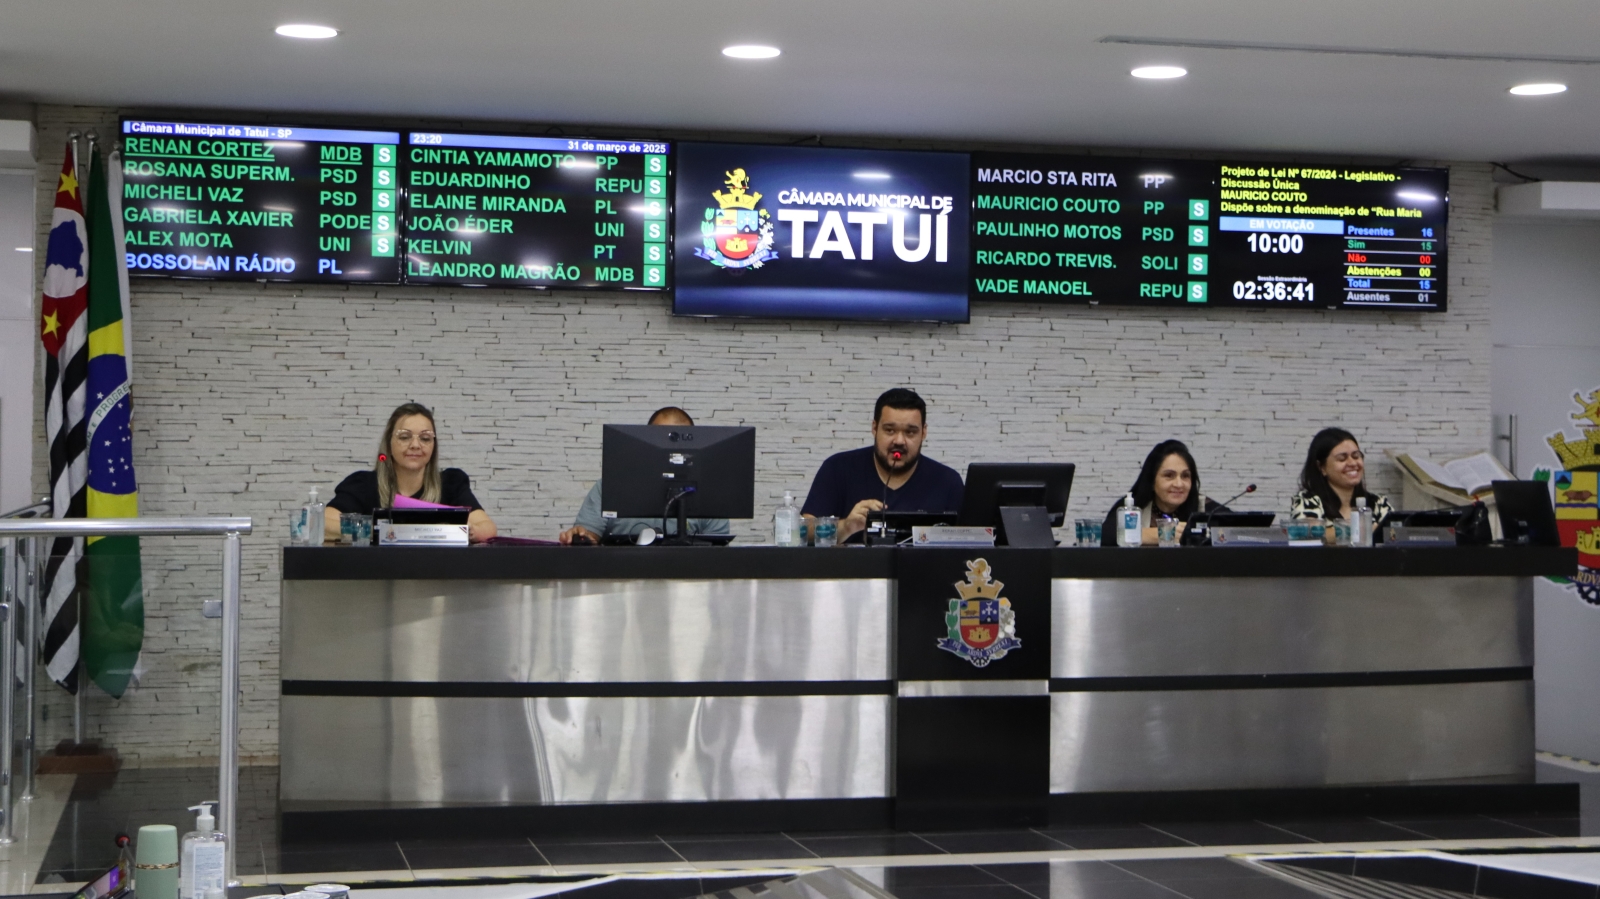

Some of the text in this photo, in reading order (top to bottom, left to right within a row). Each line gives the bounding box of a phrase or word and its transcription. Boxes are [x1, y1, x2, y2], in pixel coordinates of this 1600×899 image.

[131, 122, 172, 135] Câmara
[175, 124, 227, 137] Municipal
[229, 127, 242, 136] de
[277, 129, 292, 138] SP
[413, 134, 442, 144] 23:20
[125, 138, 391, 163] RENAN CORTEZ MDB S
[567, 141, 666, 153] 31 de março de 2025
[410, 149, 661, 172] CINTIA YAMAMOTO PP S
[124, 161, 390, 185] ROSANA SUPERM. PSD S
[410, 171, 661, 194] EDUARDINHO REPU S
[977, 168, 1165, 188] MARCIO STA RITA PP
[1221, 166, 1255, 178] Projeto
[1257, 167, 1270, 177] de
[1271, 168, 1286, 178] Lei
[1301, 169, 1337, 180] 67/2024
[1344, 170, 1395, 182] Legislativo
[1221, 178, 1300, 190] Discussão Única
[124, 184, 390, 208] MICHELI VAZ PSD S
[410, 194, 661, 216] ELAINE MIRANDA PL S
[778, 188, 953, 209] CÂMARA MUNICIPAL DE
[977, 195, 1204, 217] MAURICIO COUTO PP S
[1221, 190, 1308, 202] MAURICIO COUTO
[124, 207, 389, 231] GABRIELA XAVIER PODE S
[1220, 202, 1254, 214] Dispõe
[1255, 203, 1283, 213] sobre
[1284, 205, 1291, 214] a
[1293, 204, 1356, 217] denominação
[1357, 206, 1369, 216] de
[1396, 208, 1422, 218] Maria
[409, 214, 660, 238] JOÃO ÉDER UNI S
[777, 207, 953, 262] TATUÍ
[977, 222, 1204, 243] PAULINHO MOTOS PSD S
[1249, 219, 1315, 231] EM VOTAÇÃO
[1348, 226, 1432, 238] Presentes 16
[124, 230, 389, 253] ALEX MOTA UNI S
[408, 239, 660, 260] KELVIN PT S
[1247, 233, 1303, 254] 10:00
[1348, 240, 1432, 250] Sim 15
[125, 253, 342, 274] BOSSOLAN RÁDIO PL
[977, 251, 1203, 271] RICARDO TREVIS. SOLI S
[1347, 253, 1431, 264] Não 00
[408, 262, 660, 283] LEANDRO MAGRÃO MDB S
[1347, 266, 1431, 277] Abstenções 00
[976, 279, 1203, 299] VADE MANOEL REPU S
[1233, 281, 1314, 301] 02:36:41
[1347, 278, 1430, 289] Total 15
[1347, 292, 1429, 302] Ausentes 01
[682, 433, 694, 441] LG
